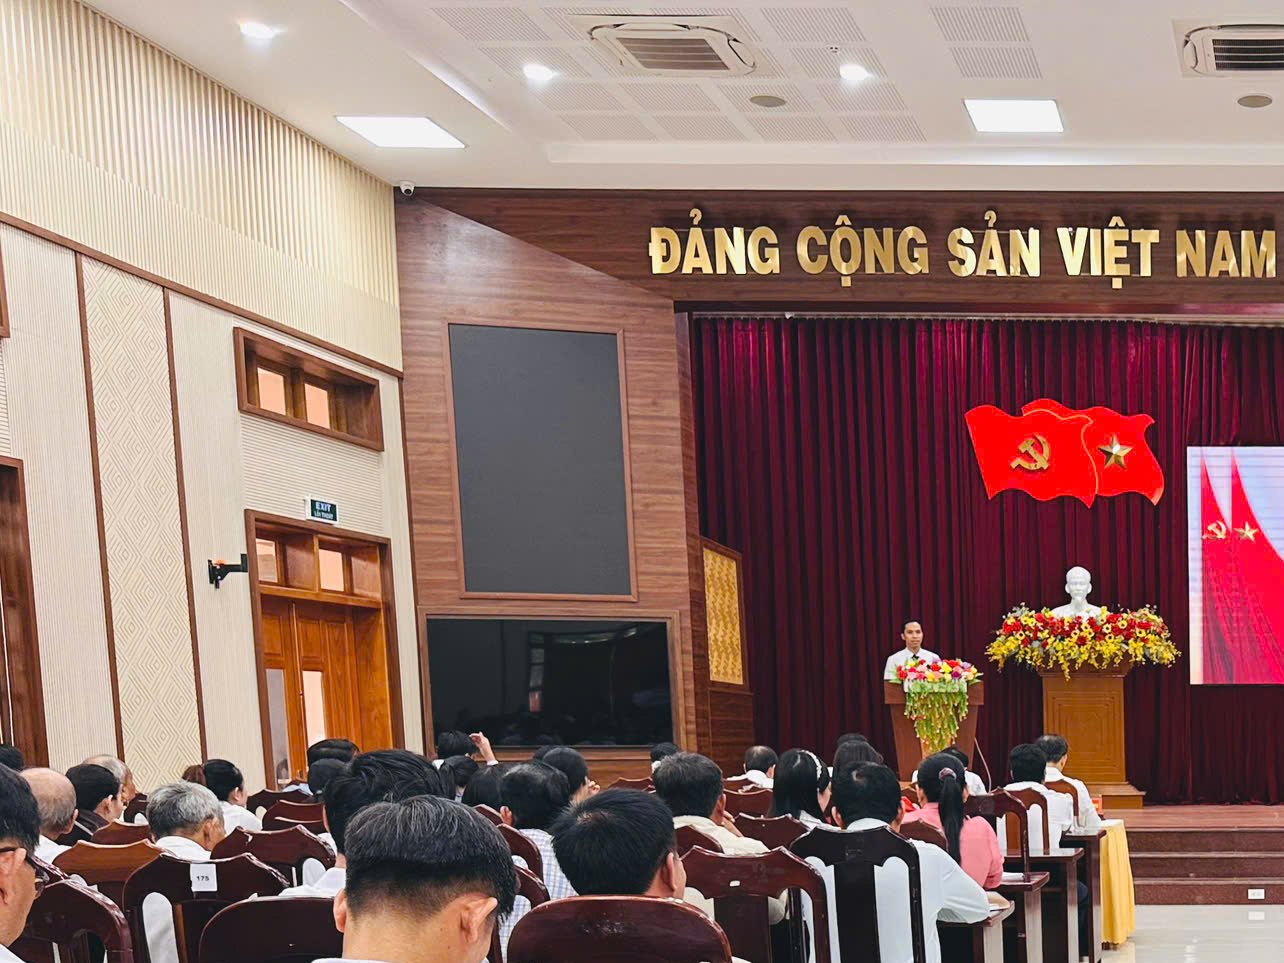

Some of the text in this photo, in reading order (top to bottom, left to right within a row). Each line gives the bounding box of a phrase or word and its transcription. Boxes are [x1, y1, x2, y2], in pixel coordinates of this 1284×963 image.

[648, 208, 780, 274] ĐẢNG
[797, 215, 929, 287] CỘNG
[947, 210, 1041, 277] SẢN
[1057, 216, 1160, 288] VIỆT
[1176, 229, 1276, 278] NAM
[315, 502, 331, 512] EXIT
